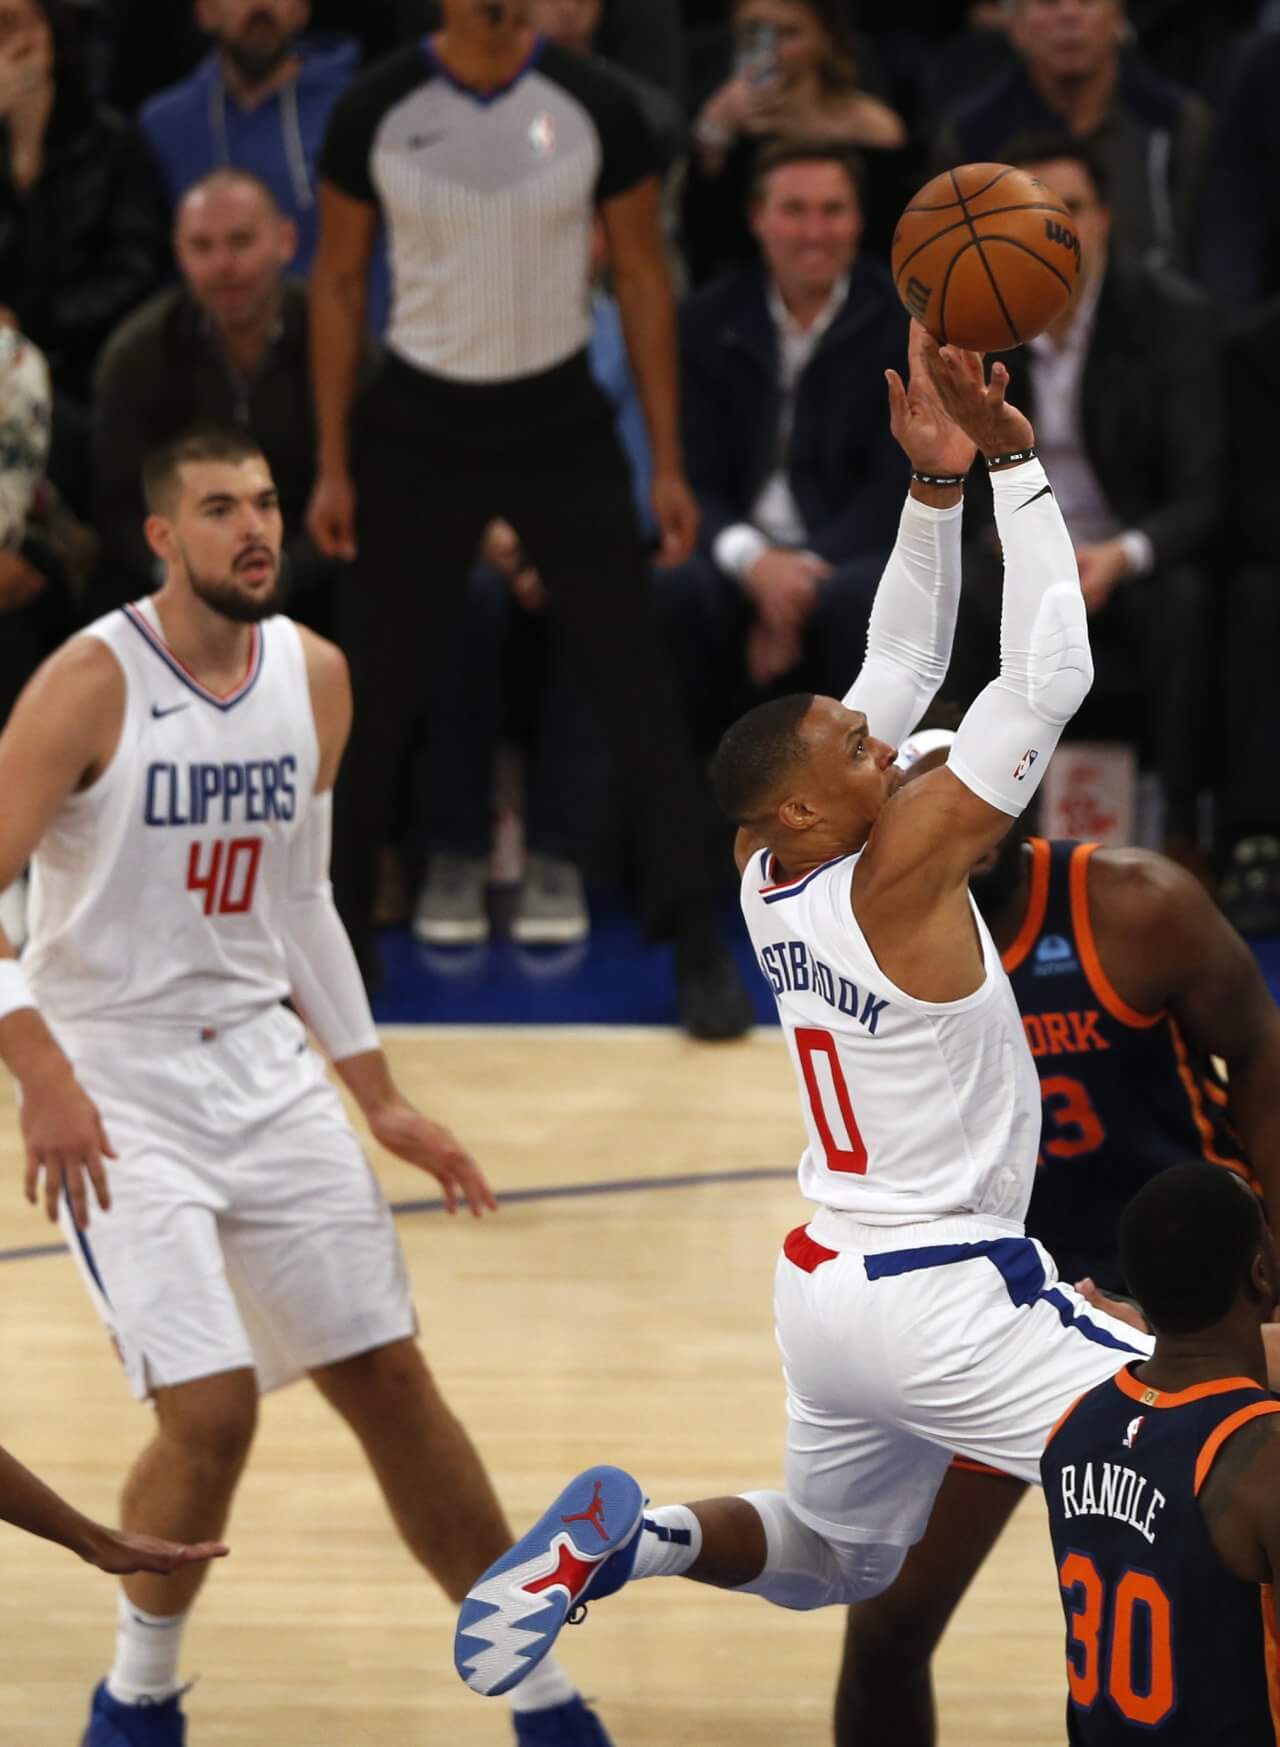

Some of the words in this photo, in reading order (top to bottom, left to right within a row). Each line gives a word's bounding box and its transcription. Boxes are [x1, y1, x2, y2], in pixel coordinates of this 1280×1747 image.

[143, 754, 297, 827] CLIPPERS
[185, 837, 263, 917] 40
[1021, 1010, 1109, 1056] ORK
[794, 1026, 868, 1175] 0
[1038, 1074, 1105, 1165] 3
[1061, 1462, 1166, 1544] RANDLE
[1058, 1547, 1177, 1729] 30
